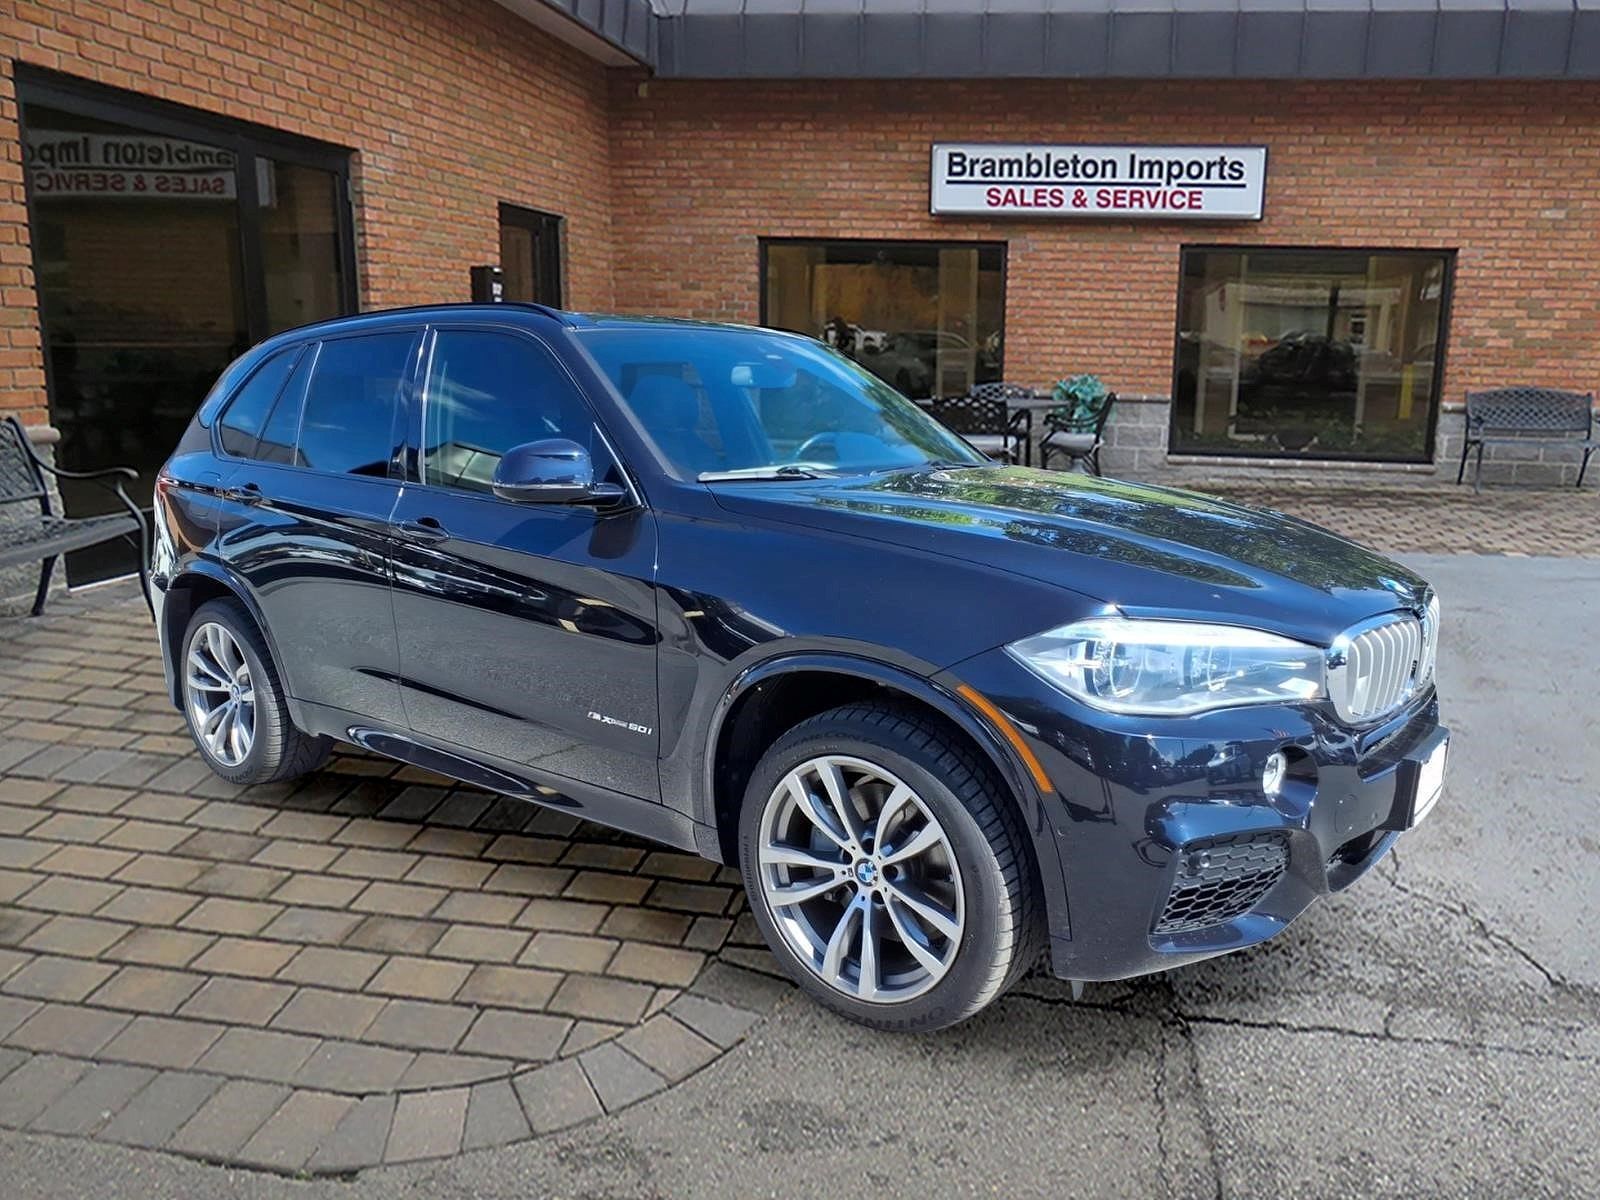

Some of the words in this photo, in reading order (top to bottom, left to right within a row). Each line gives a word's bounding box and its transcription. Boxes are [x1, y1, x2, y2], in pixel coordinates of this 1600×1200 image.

[947, 151, 1117, 179] Brambleton
[1129, 153, 1246, 186] Imports
[986, 187, 1064, 208] SALES
[1071, 190, 1088, 208] &
[1096, 189, 1203, 209] SERVICE
